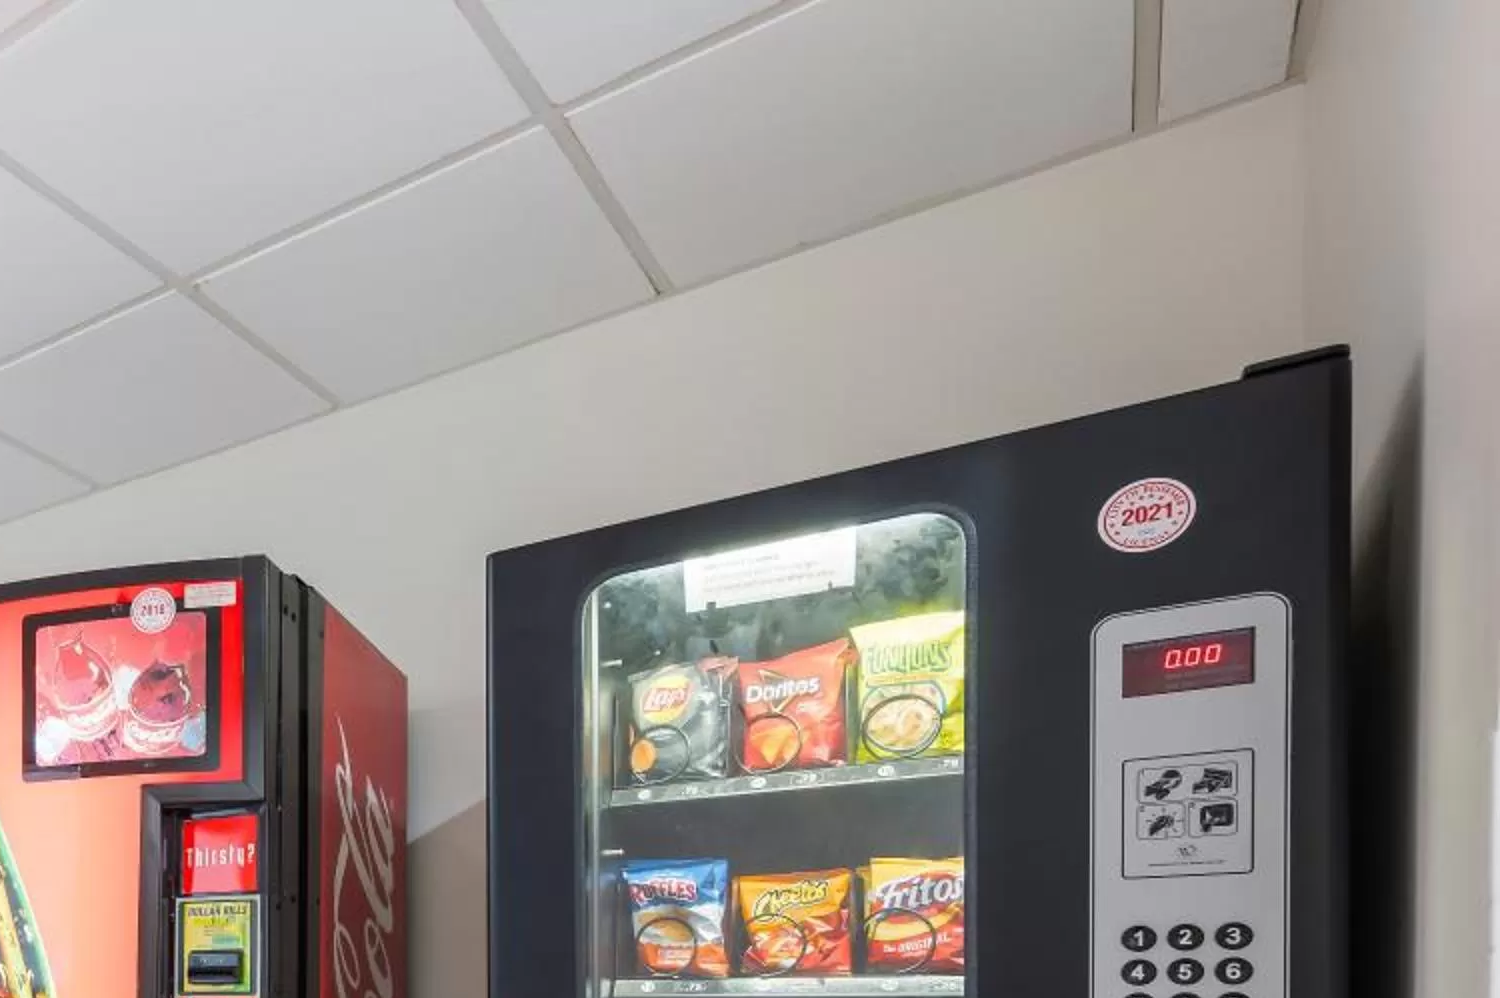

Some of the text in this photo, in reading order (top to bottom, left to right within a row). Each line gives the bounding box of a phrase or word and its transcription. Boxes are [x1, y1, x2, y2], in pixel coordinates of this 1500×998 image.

[1122, 502, 1173, 527] 2021
[746, 678, 820, 702] Doritos
[185, 842, 256, 869] Thirsty?
[1134, 927, 1242, 947] 1 2 3
[1131, 962, 1242, 980] 4 5 6
